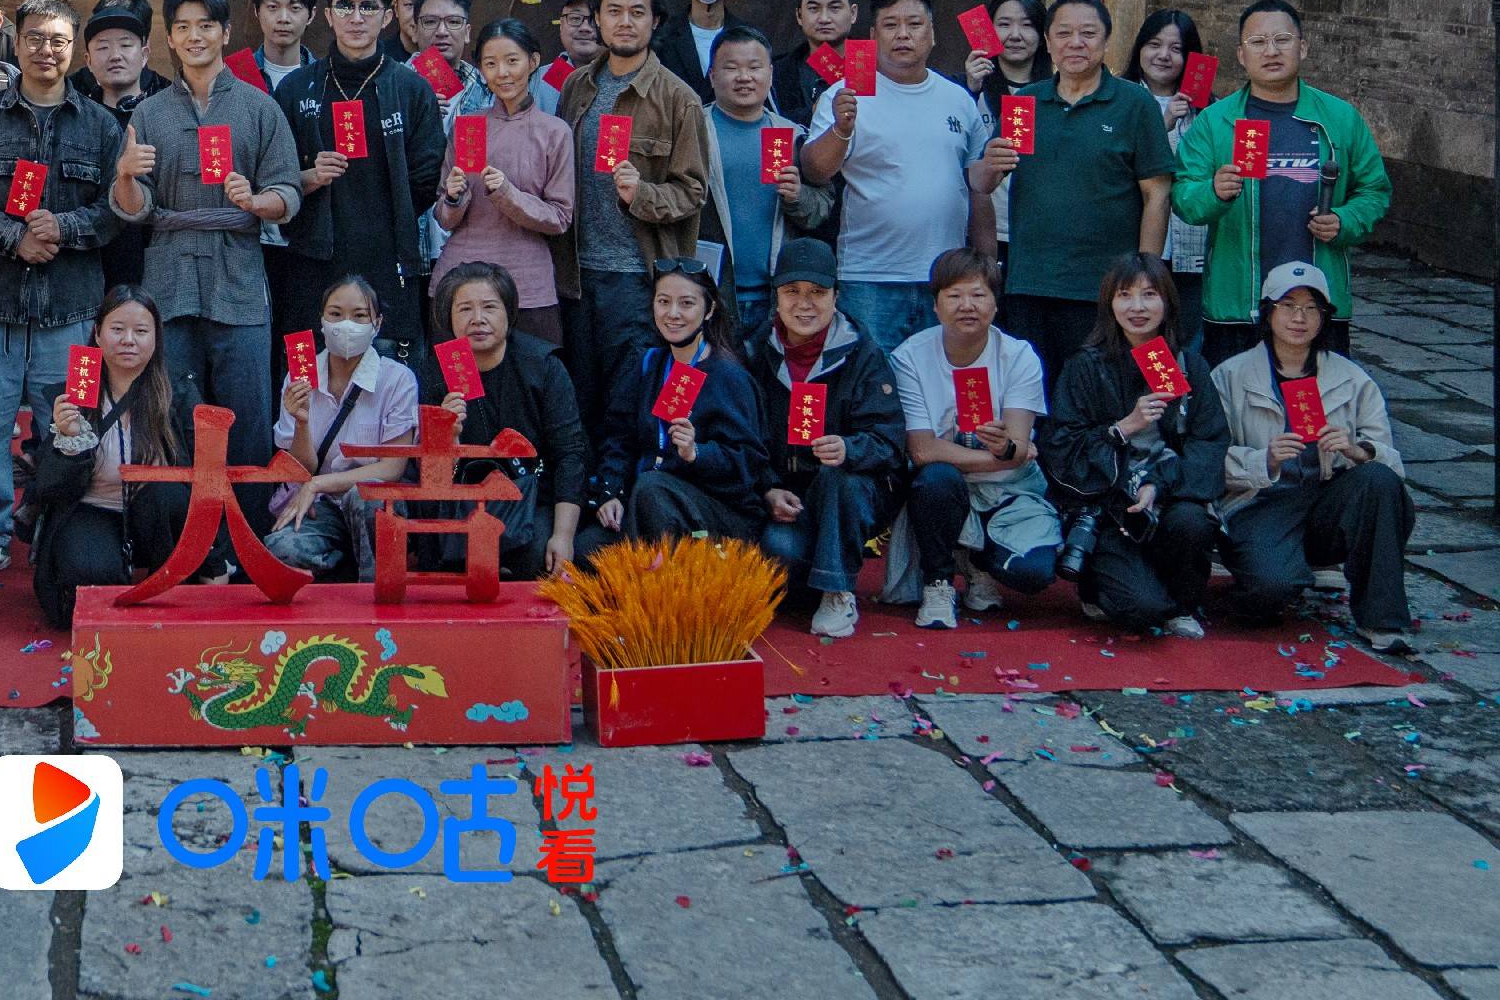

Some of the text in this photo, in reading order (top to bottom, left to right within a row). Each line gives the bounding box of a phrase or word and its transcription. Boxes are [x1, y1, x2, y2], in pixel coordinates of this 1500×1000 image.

[344, 110, 355, 153] 开机大吉
[1013, 106, 1025, 149] 开机大吉
[210, 135, 222, 179] 开机大吉
[1245, 129, 1256, 172] 开机大吉
[18, 172, 35, 212] 开机大吉
[77, 356, 89, 400] 开机大吉
[801, 394, 813, 440] 开机大吉
[116, 404, 538, 604] 大吉
